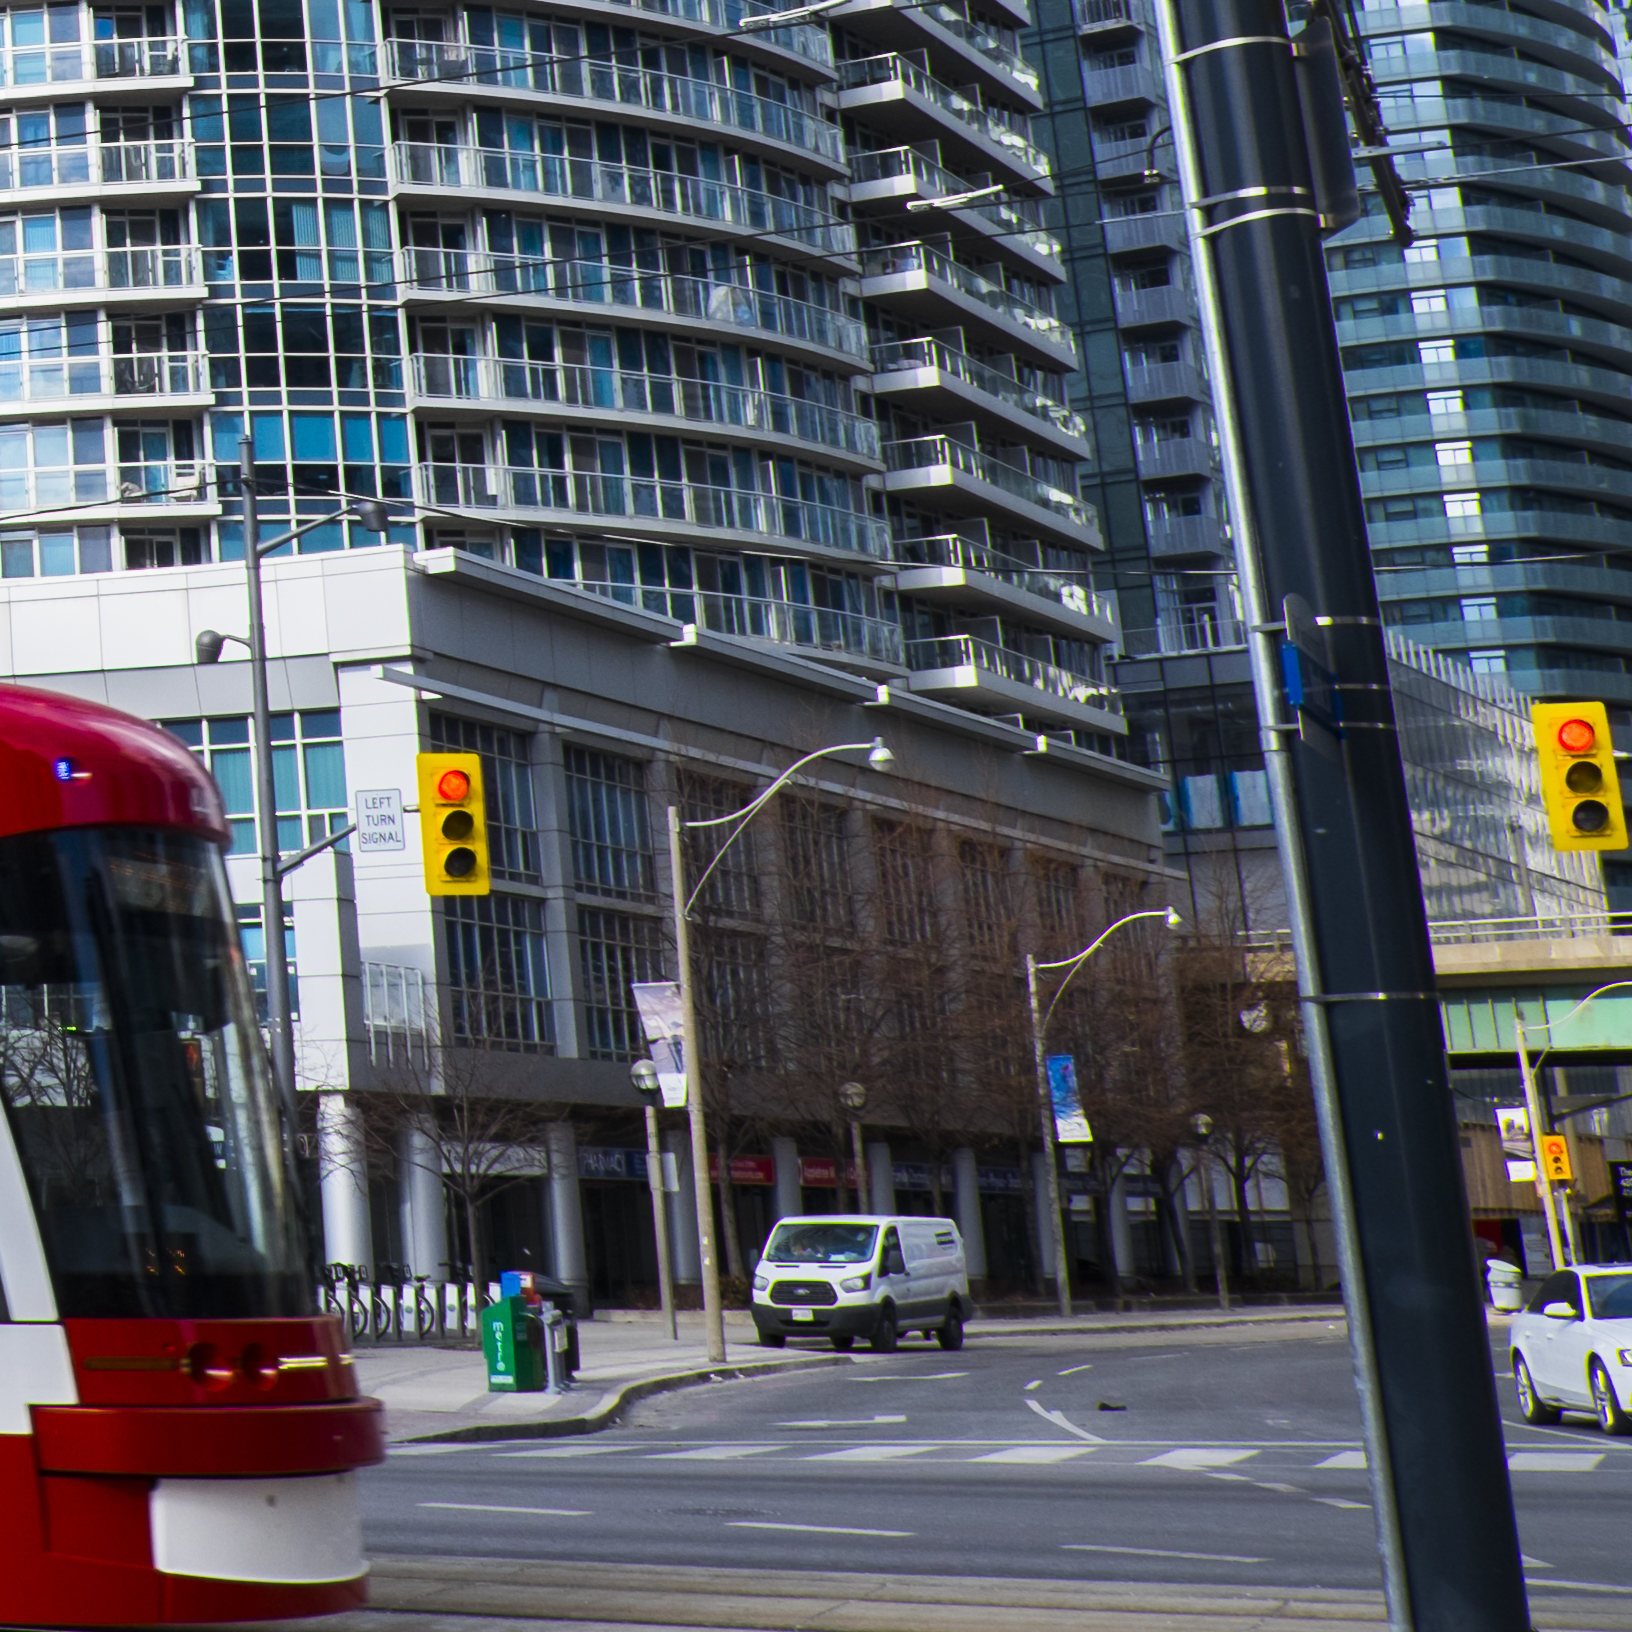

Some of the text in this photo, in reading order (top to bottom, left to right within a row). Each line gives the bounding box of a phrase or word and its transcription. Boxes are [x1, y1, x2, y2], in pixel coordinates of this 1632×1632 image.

[364, 796, 393, 810] LEFT
[365, 813, 396, 828] TURN
[361, 830, 402, 845] SIGNAL
